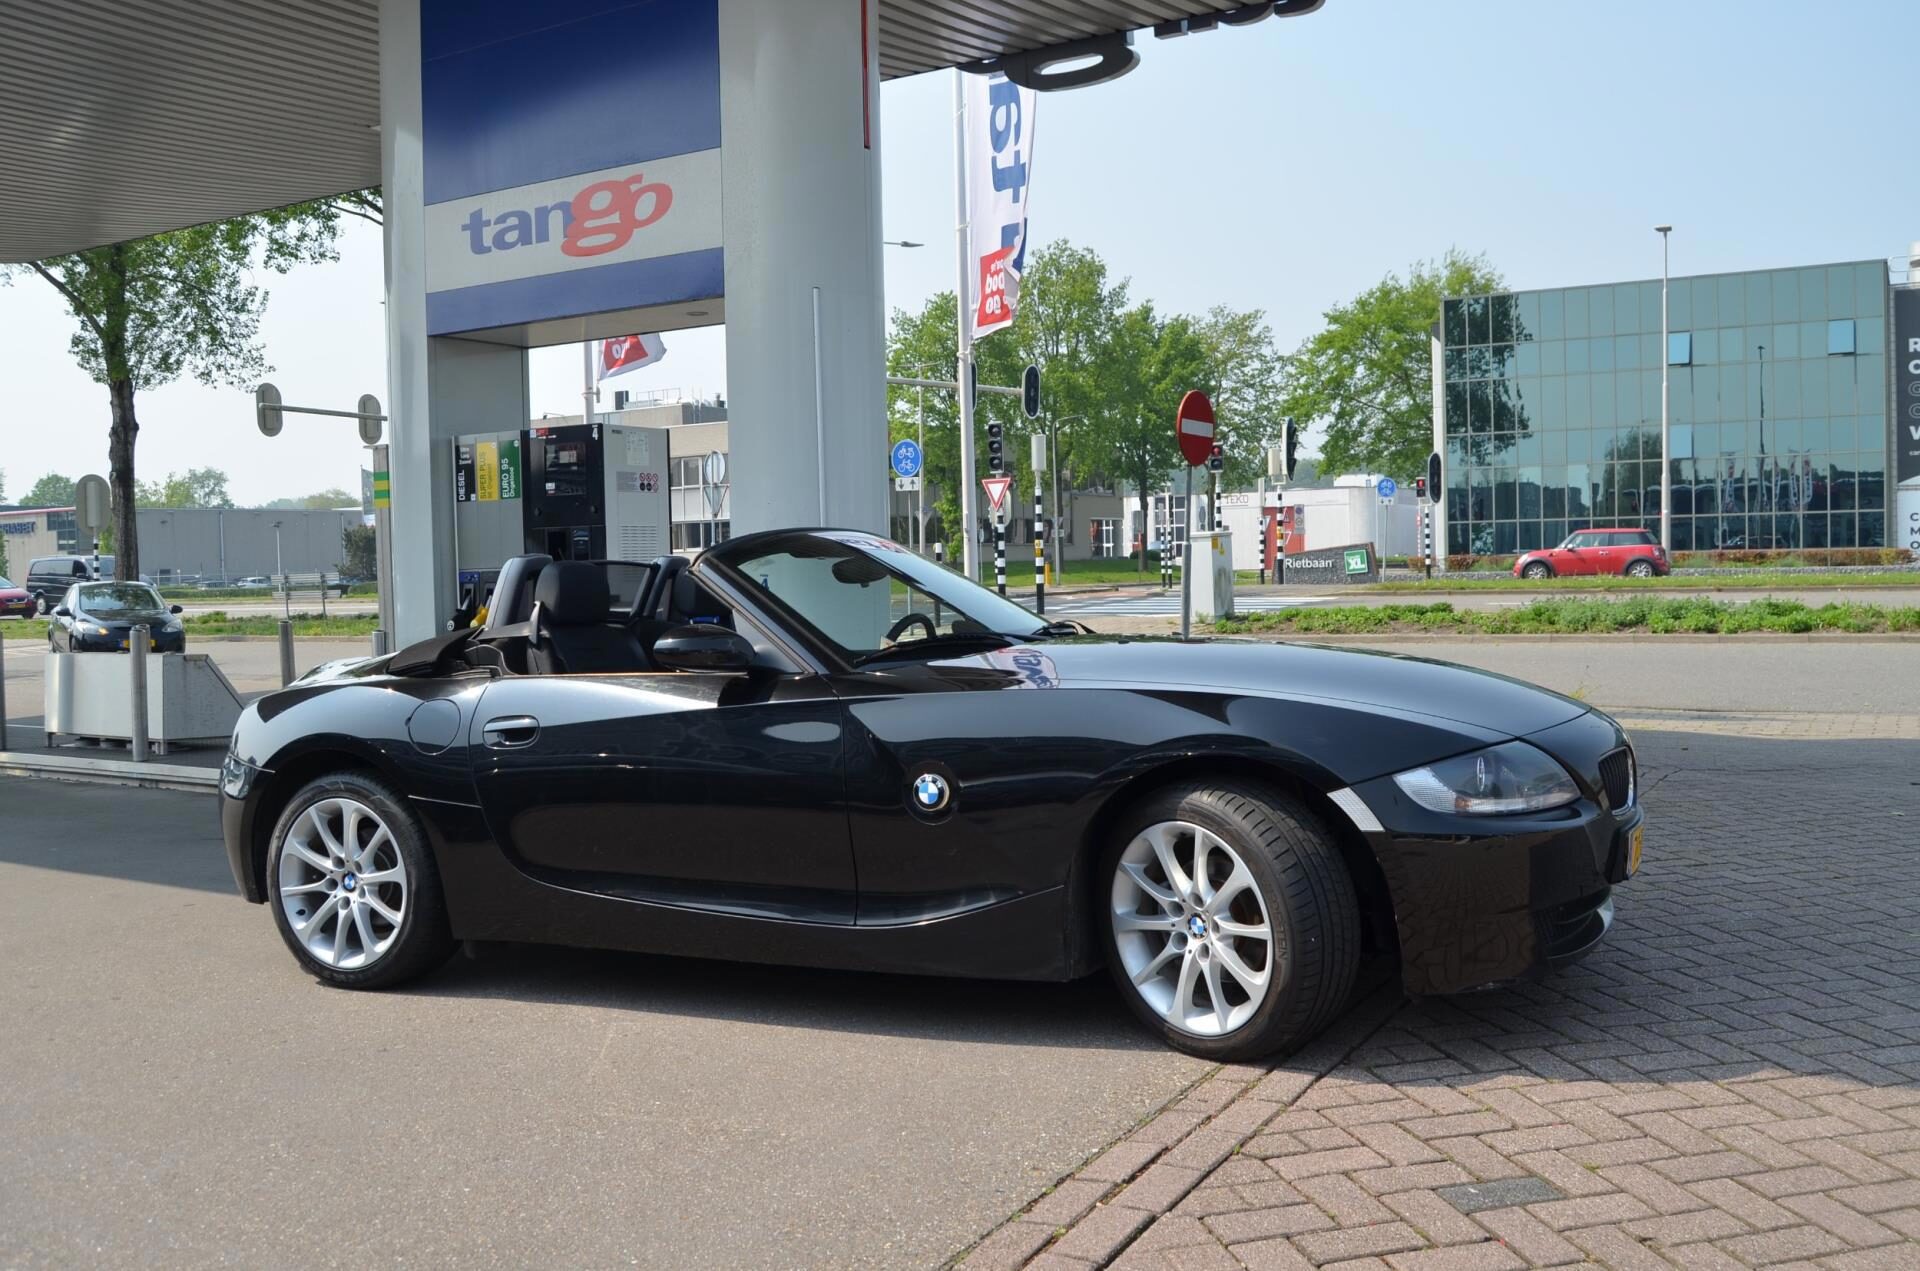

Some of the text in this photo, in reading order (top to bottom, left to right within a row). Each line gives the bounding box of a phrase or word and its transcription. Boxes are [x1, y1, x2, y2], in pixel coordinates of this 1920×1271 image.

[461, 173, 673, 257] tango
[592, 427, 599, 440] 4
[458, 469, 466, 501] DIESEL
[501, 457, 510, 498] EURO 95
[1285, 558, 1332, 568] Rietbaan
